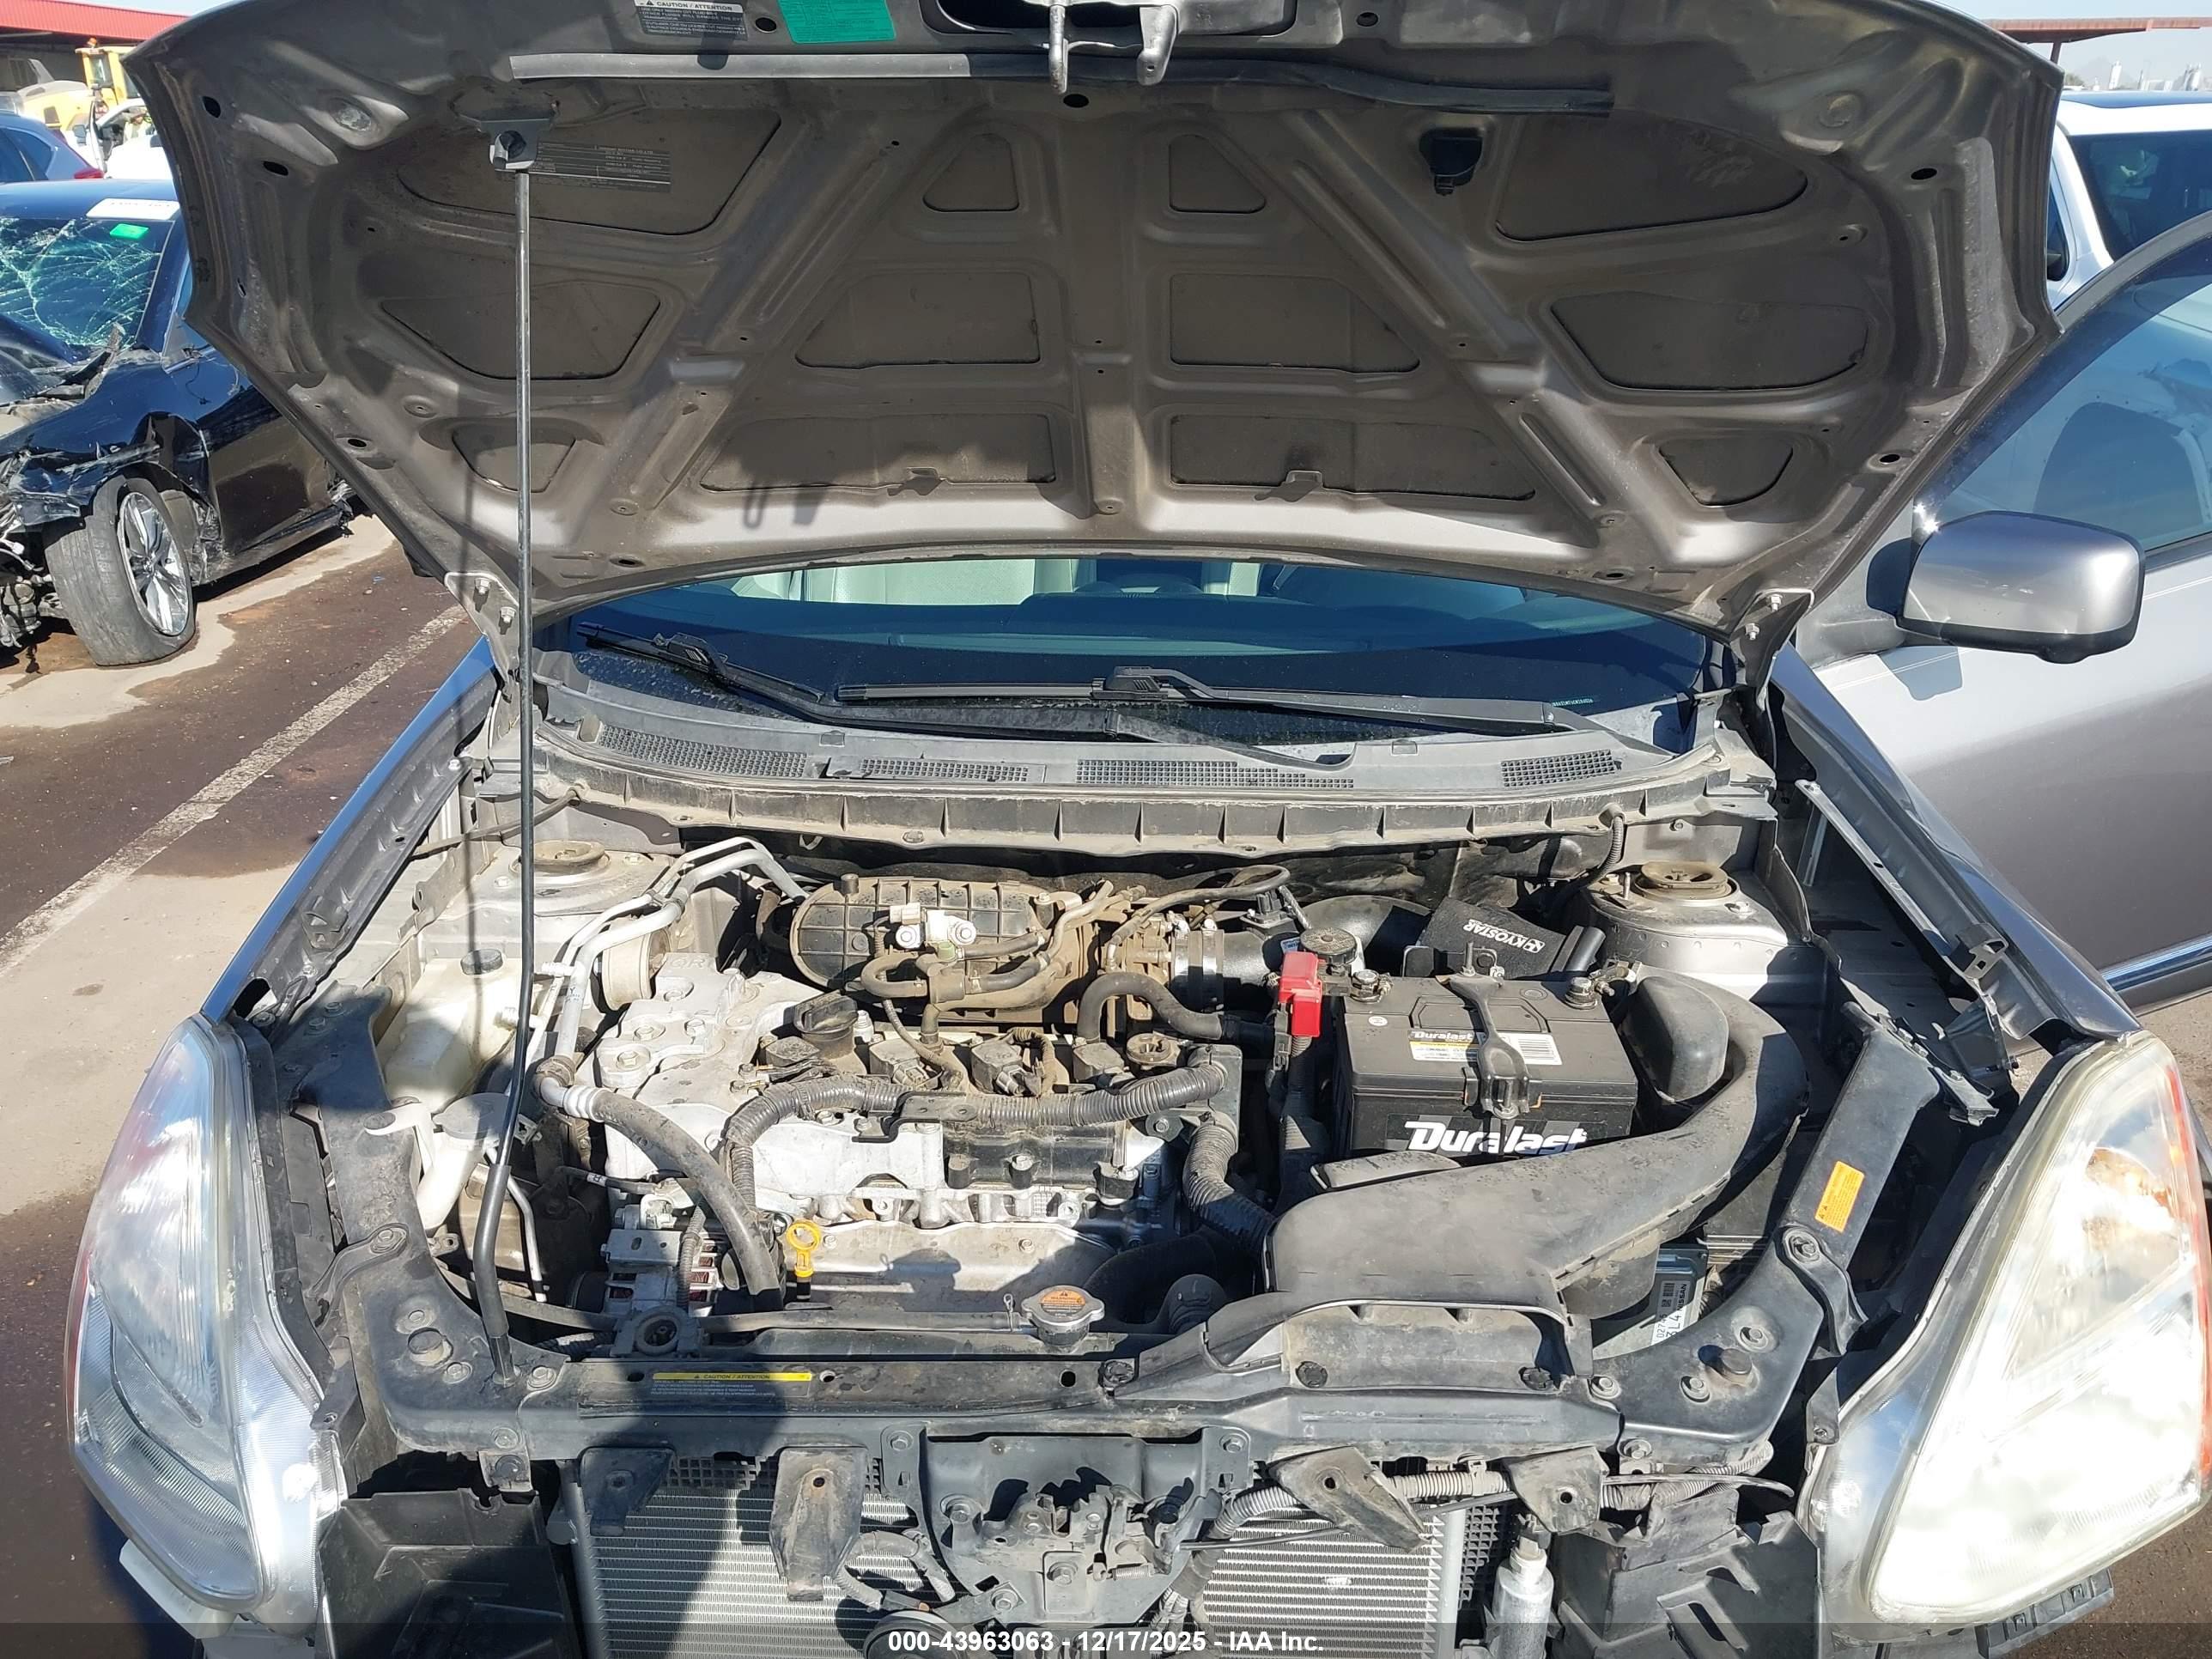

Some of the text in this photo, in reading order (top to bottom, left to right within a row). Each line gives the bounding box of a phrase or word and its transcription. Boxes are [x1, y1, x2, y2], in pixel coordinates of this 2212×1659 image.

[1462, 921, 1527, 949] KYOSTAR
[1411, 1030, 1474, 1041] Duralast
[1404, 1121, 1588, 1155] Duralast
[1677, 1284, 1687, 1311] NISSAN
